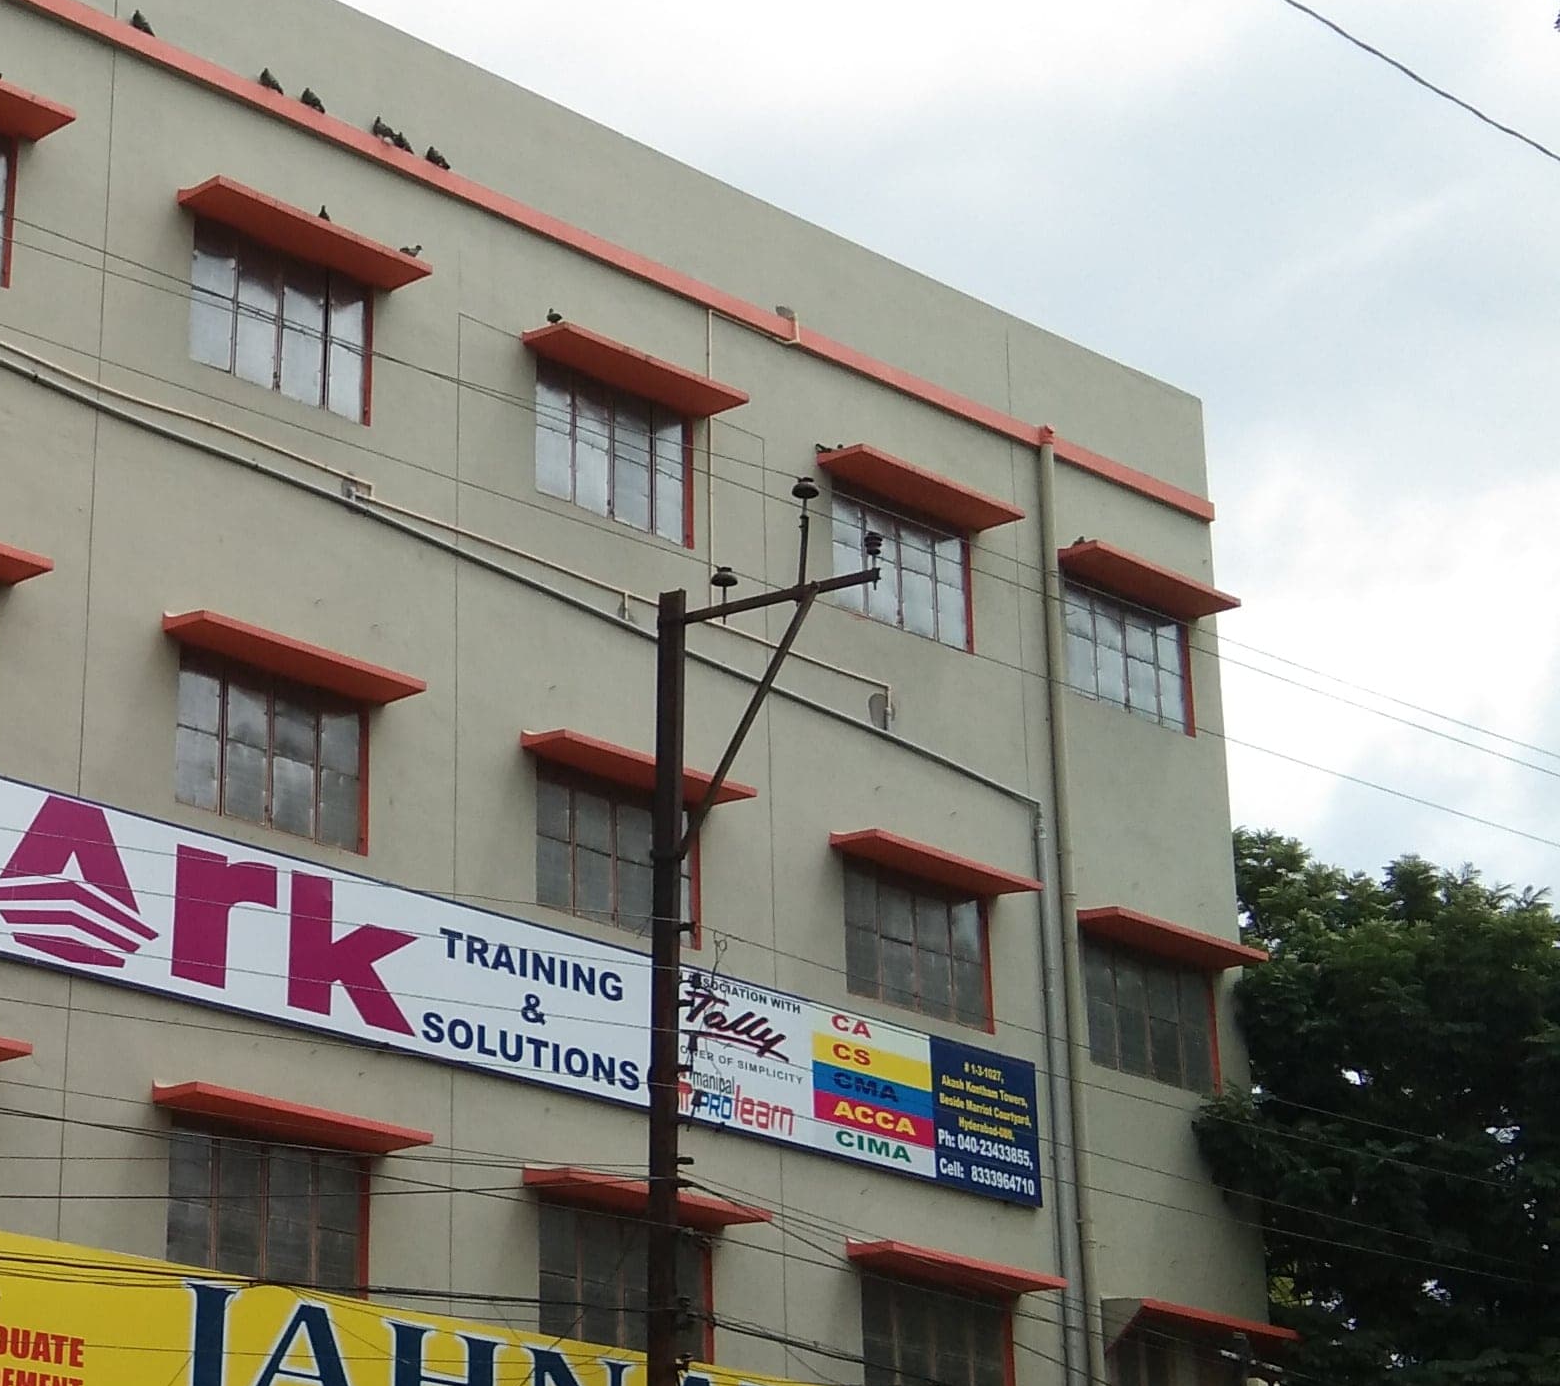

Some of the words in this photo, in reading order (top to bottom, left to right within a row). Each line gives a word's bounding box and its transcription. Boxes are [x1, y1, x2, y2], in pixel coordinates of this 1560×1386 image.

[439, 926, 624, 1002] TRAINING
[521, 992, 547, 1026] &
[771, 997, 801, 1014] WITH
[684, 989, 789, 1062] Tally
[831, 1013, 872, 1039] CA
[421, 1012, 640, 1090] SOLUTIONS
[832, 1043, 871, 1067] CS
[693, 1071, 735, 1096] manipal
[718, 1054, 734, 1066] OF
[738, 1060, 804, 1085] SIMPLICITY
[833, 1072, 900, 1103] CMA
[833, 1100, 916, 1136] ACCA
[835, 1130, 913, 1163] CIMA
[937, 1129, 956, 1147] Ph:
[958, 1134, 1033, 1170] 040-23433855,
[939, 1158, 965, 1178] Cell:
[971, 1166, 1035, 1195] 8333964710
